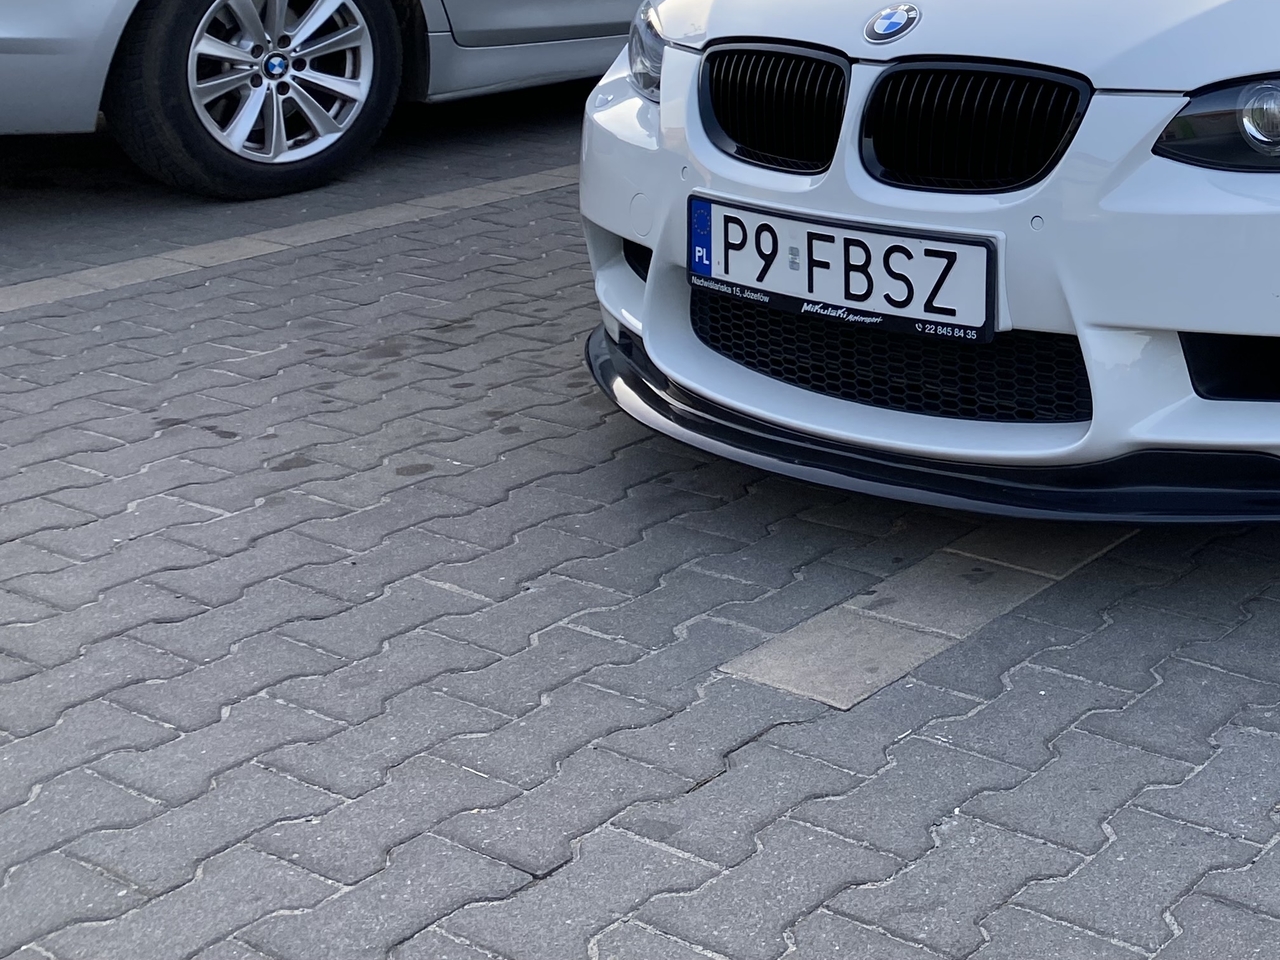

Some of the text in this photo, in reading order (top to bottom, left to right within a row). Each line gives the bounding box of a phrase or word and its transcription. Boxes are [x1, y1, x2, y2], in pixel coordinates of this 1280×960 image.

[694, 214, 958, 317] PL P9 FBSZ
[742, 289, 770, 303] Józefów
[925, 324, 977, 340] 22 845 84 35
